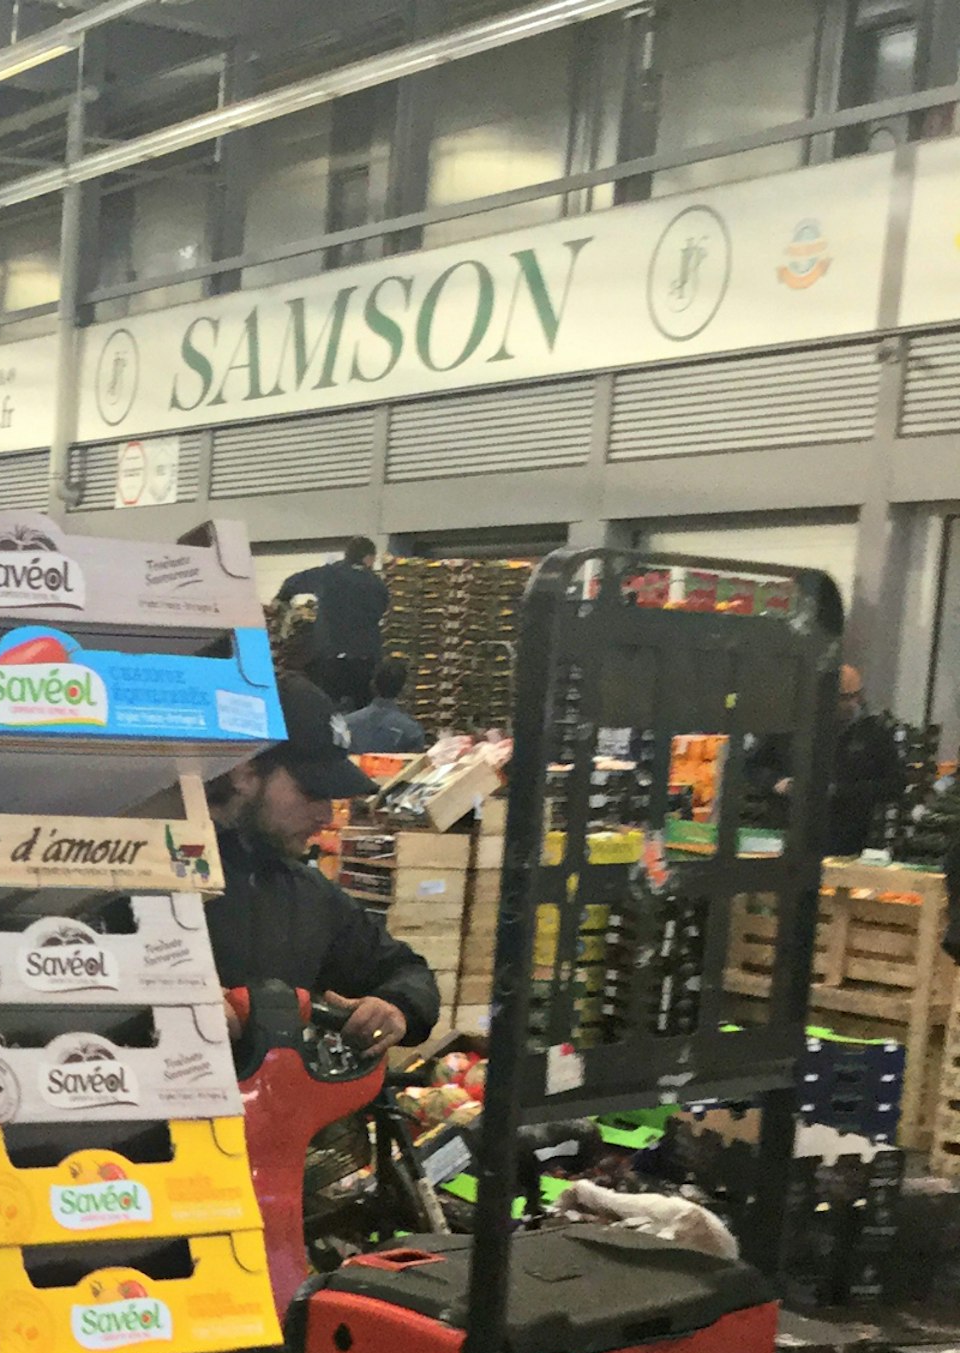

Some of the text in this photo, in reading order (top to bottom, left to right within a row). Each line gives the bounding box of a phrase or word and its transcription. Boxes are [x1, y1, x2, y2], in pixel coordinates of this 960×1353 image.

[169, 236, 594, 411] SAMSON
[11, 826, 149, 865] d'amour
[27, 950, 109, 977] Savéol
[47, 1066, 130, 1094] Savéol
[59, 1184, 141, 1214] Savéol
[81, 1302, 163, 1334] Savéol
